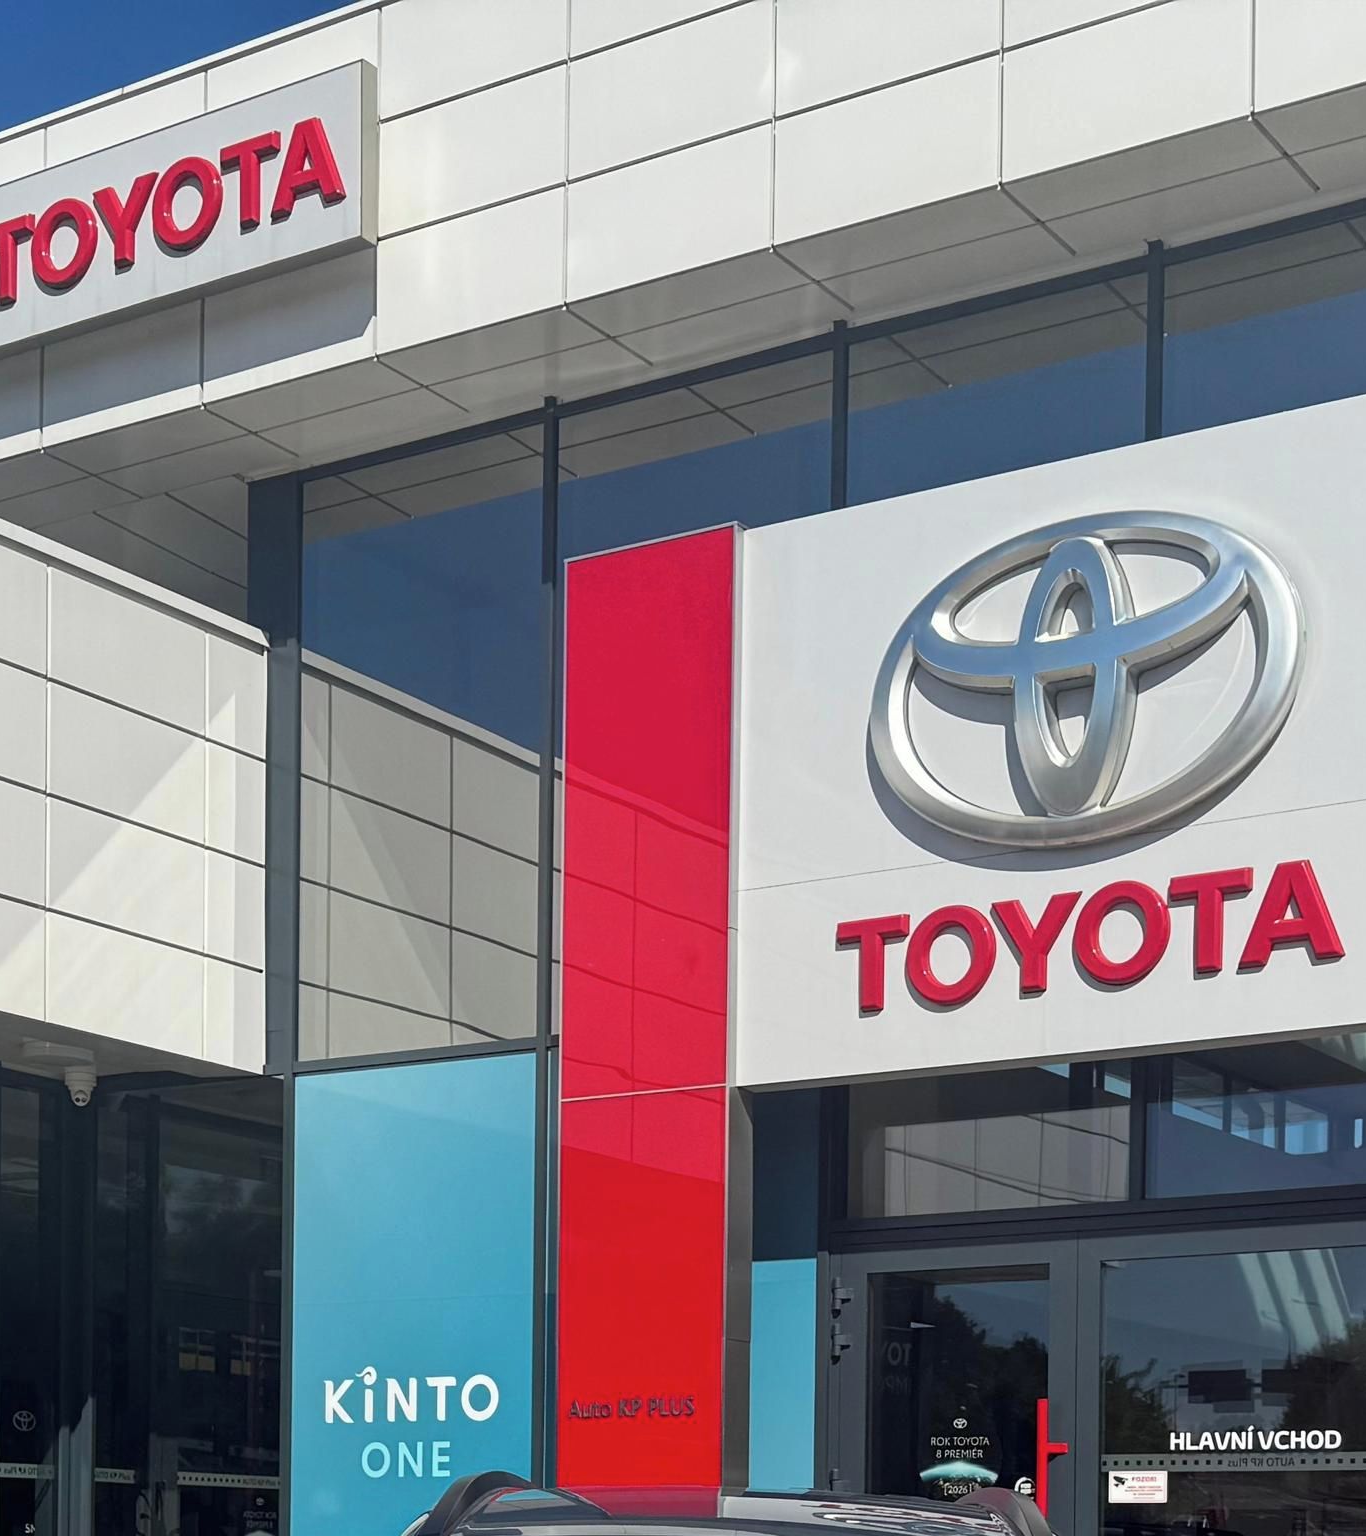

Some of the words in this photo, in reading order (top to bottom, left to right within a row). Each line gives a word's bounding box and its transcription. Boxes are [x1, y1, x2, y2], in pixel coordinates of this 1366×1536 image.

[836, 858, 1346, 1016] TOYOTA
[568, 1400, 612, 1418] Auto
[618, 1398, 642, 1417] KP
[648, 1396, 695, 1417] PLUS
[930, 1437, 951, 1447] ROK
[953, 1437, 990, 1447] TOYOTA
[1169, 1424, 1255, 1451] HLAVNÍ
[1257, 1429, 1342, 1451] VCHOD
[361, 1441, 451, 1479] ONE
